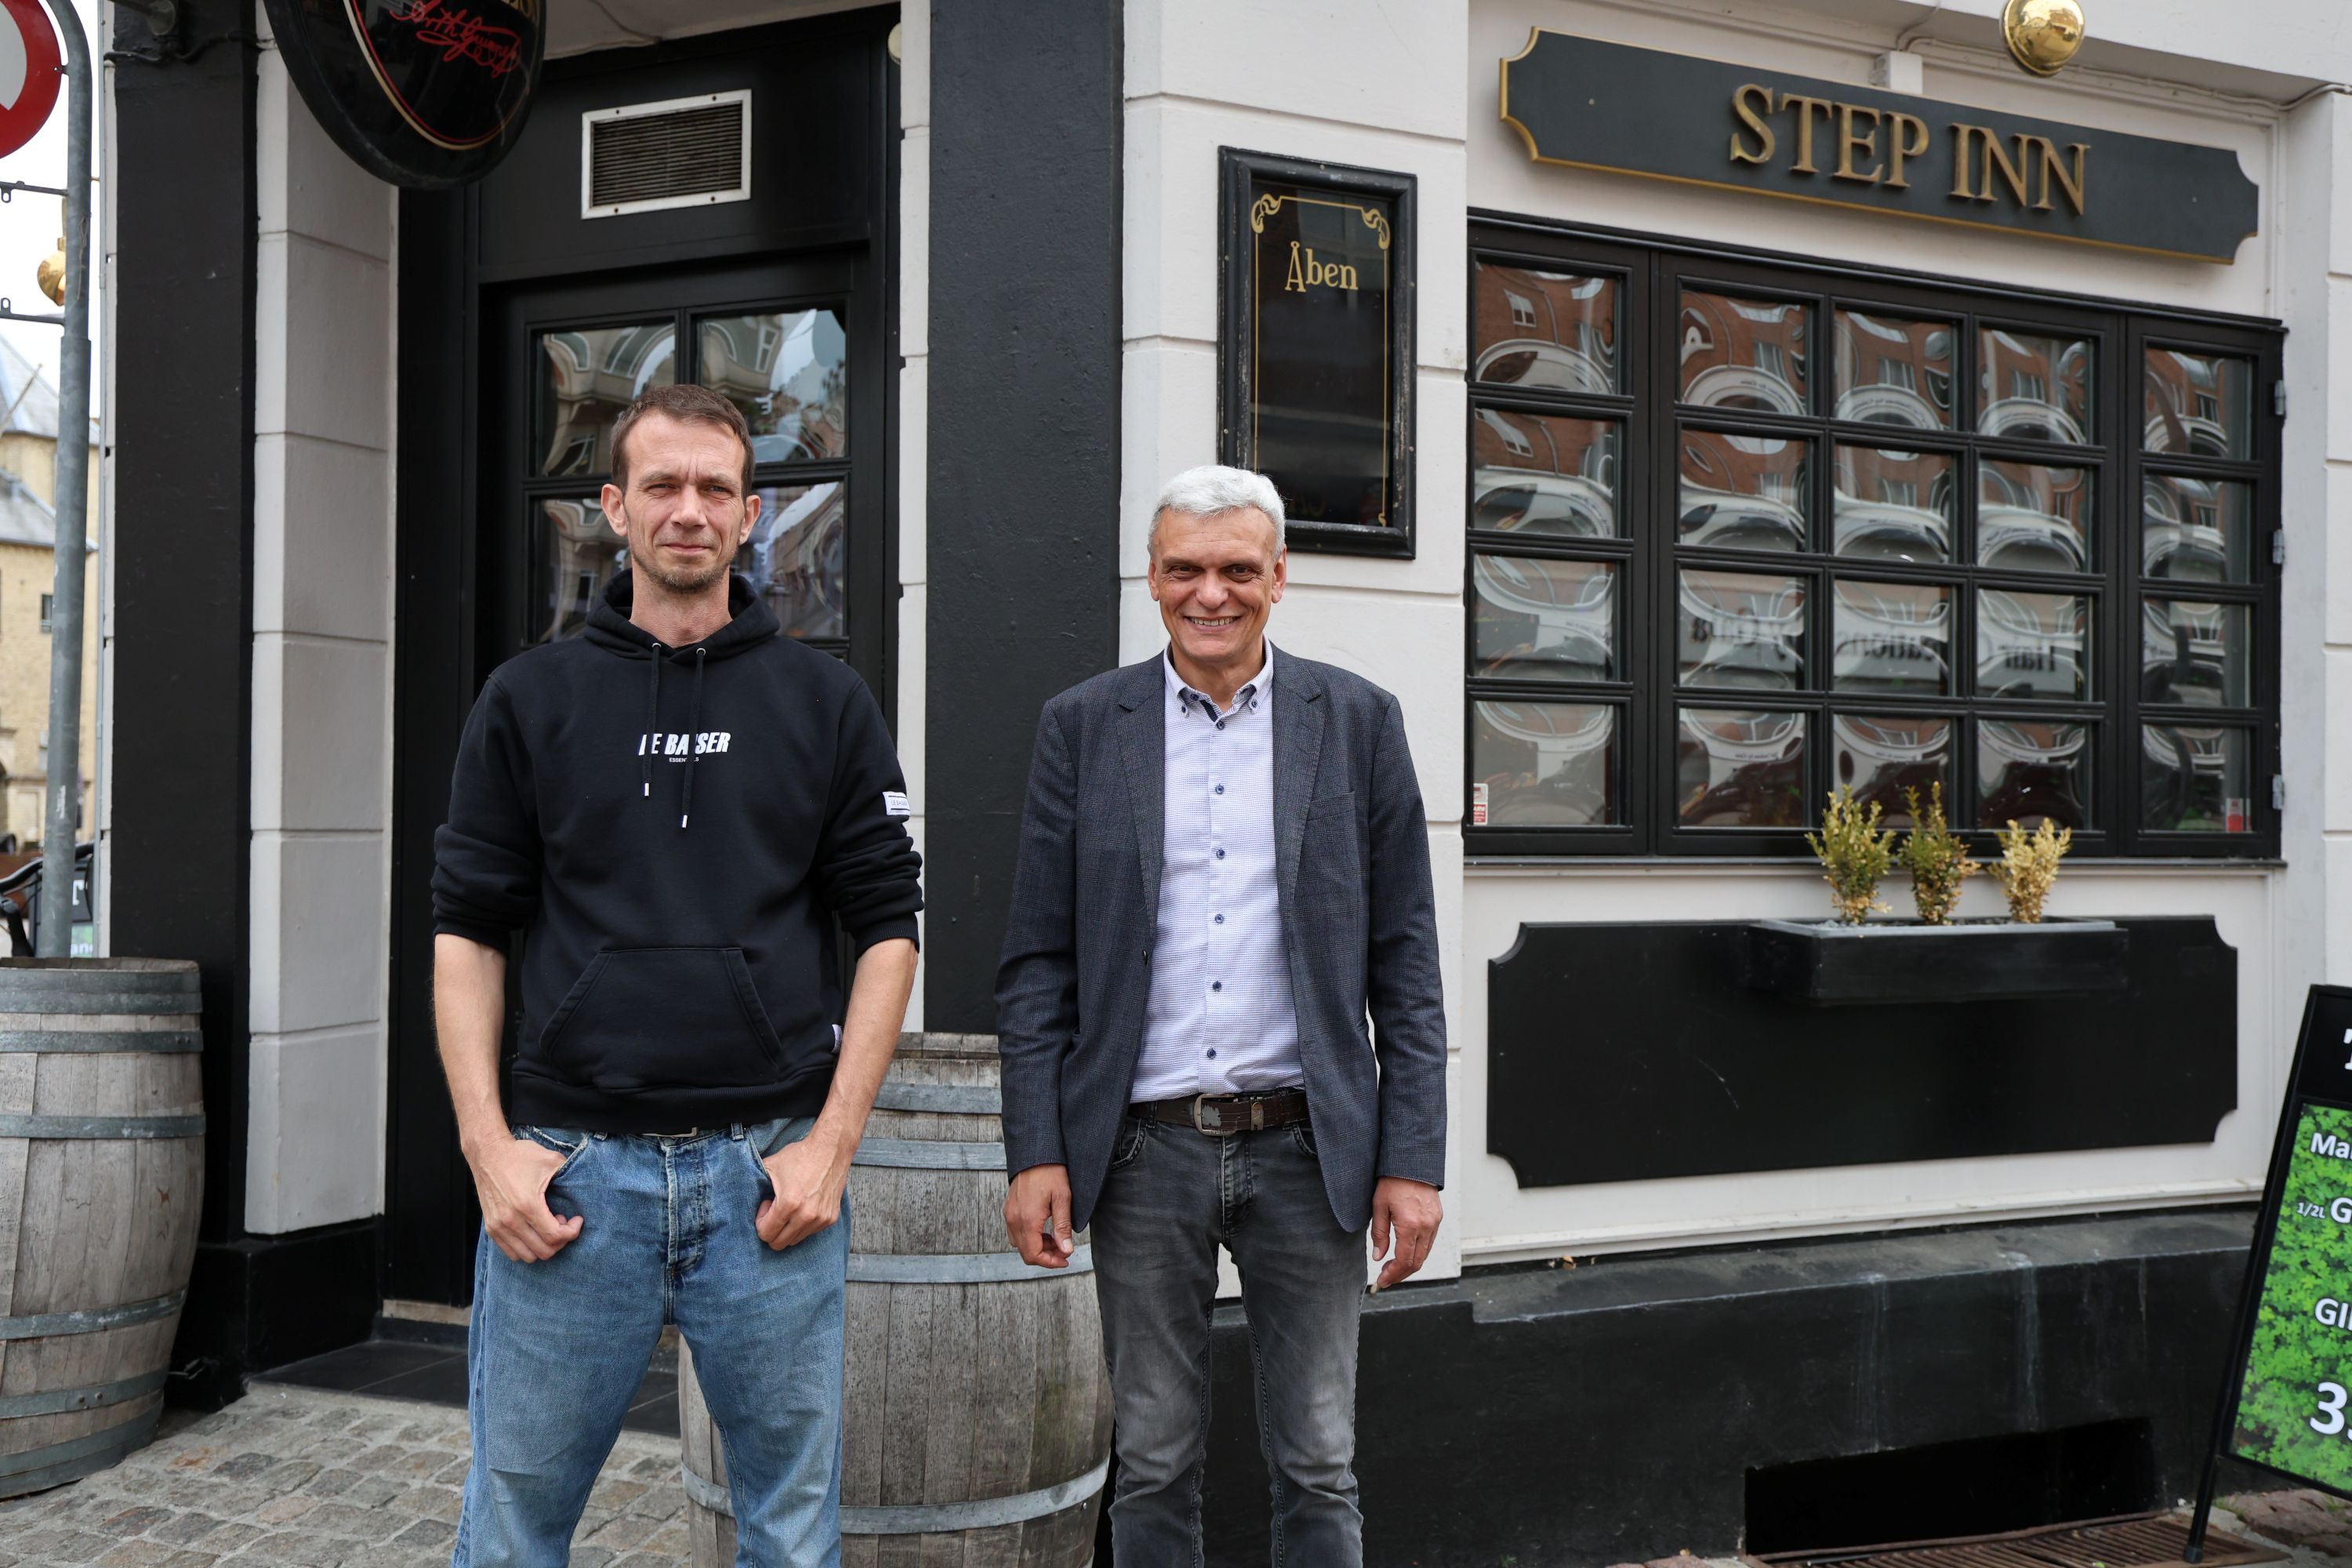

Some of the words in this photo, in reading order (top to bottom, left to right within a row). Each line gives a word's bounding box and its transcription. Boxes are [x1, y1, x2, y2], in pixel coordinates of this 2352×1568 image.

[1730, 83, 1929, 188] STEP
[1947, 122, 2092, 216] INN
[1284, 240, 1359, 293] Åben
[664, 731, 731, 755] BASER
[2310, 1132, 2352, 1160] Ma
